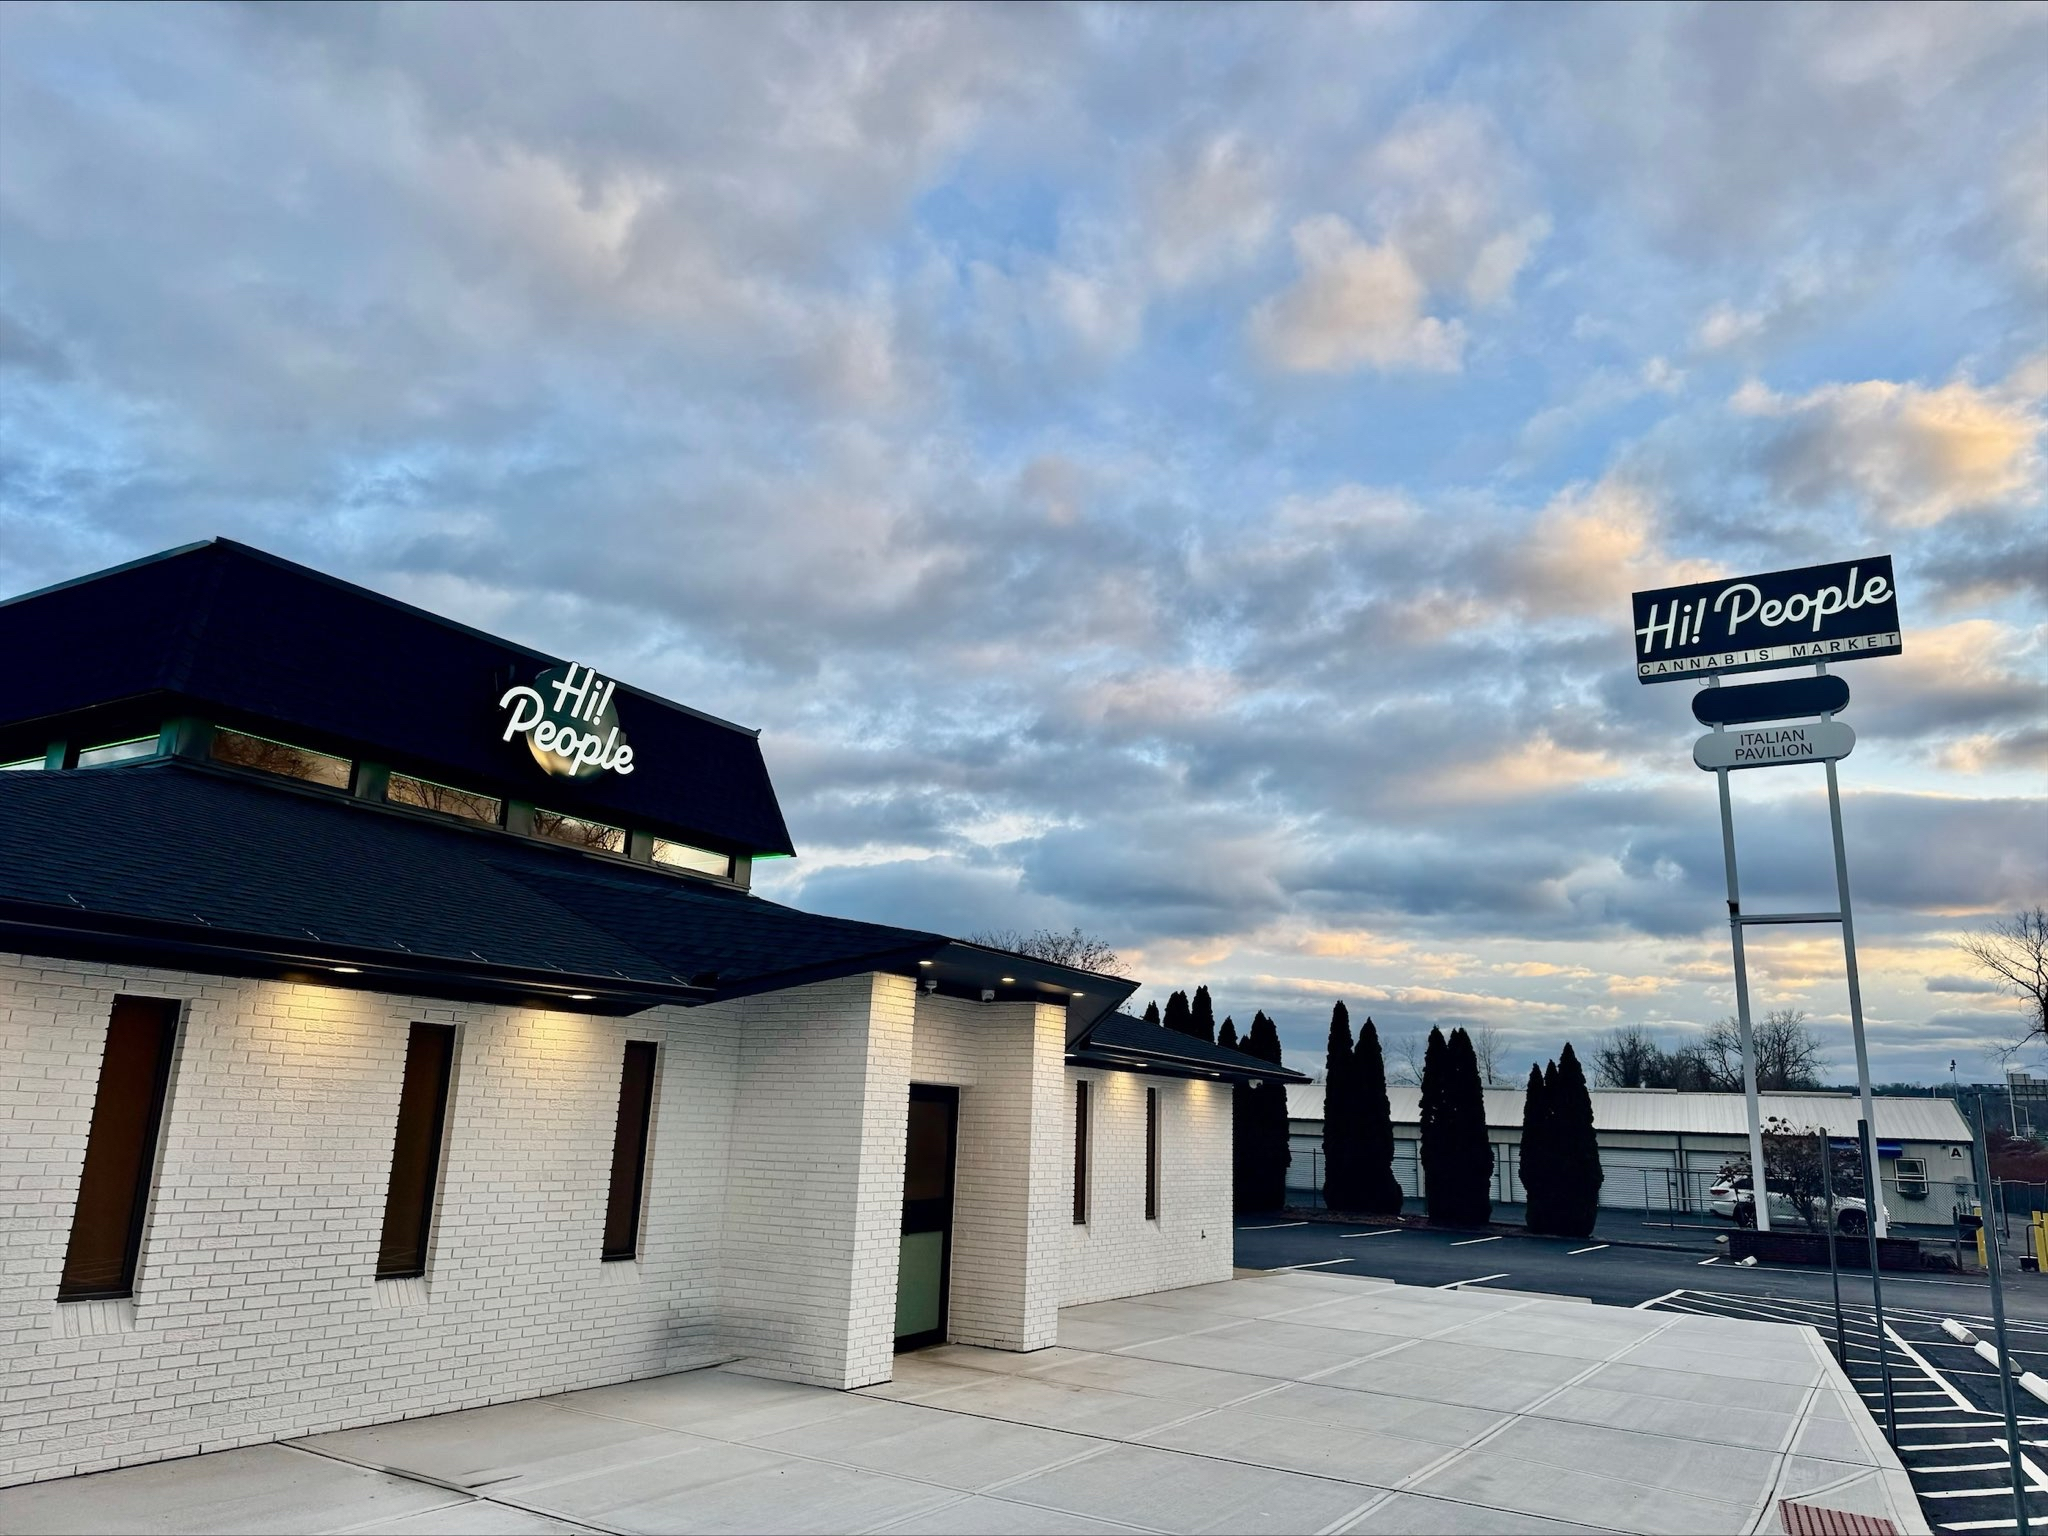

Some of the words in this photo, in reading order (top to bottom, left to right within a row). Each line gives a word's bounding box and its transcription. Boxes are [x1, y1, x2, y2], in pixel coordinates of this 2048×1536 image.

[1636, 598, 1707, 654] Hi!
[1714, 567, 1894, 635] People
[1640, 649, 1770, 676] CANNABIS
[1792, 633, 1897, 657] MARKET
[552, 662, 616, 726] Hi!
[499, 686, 635, 776] People
[1735, 742, 1813, 761] PAVILION
[1740, 729, 1805, 746] ITALIAN
[1950, 1147, 1962, 1158] A
